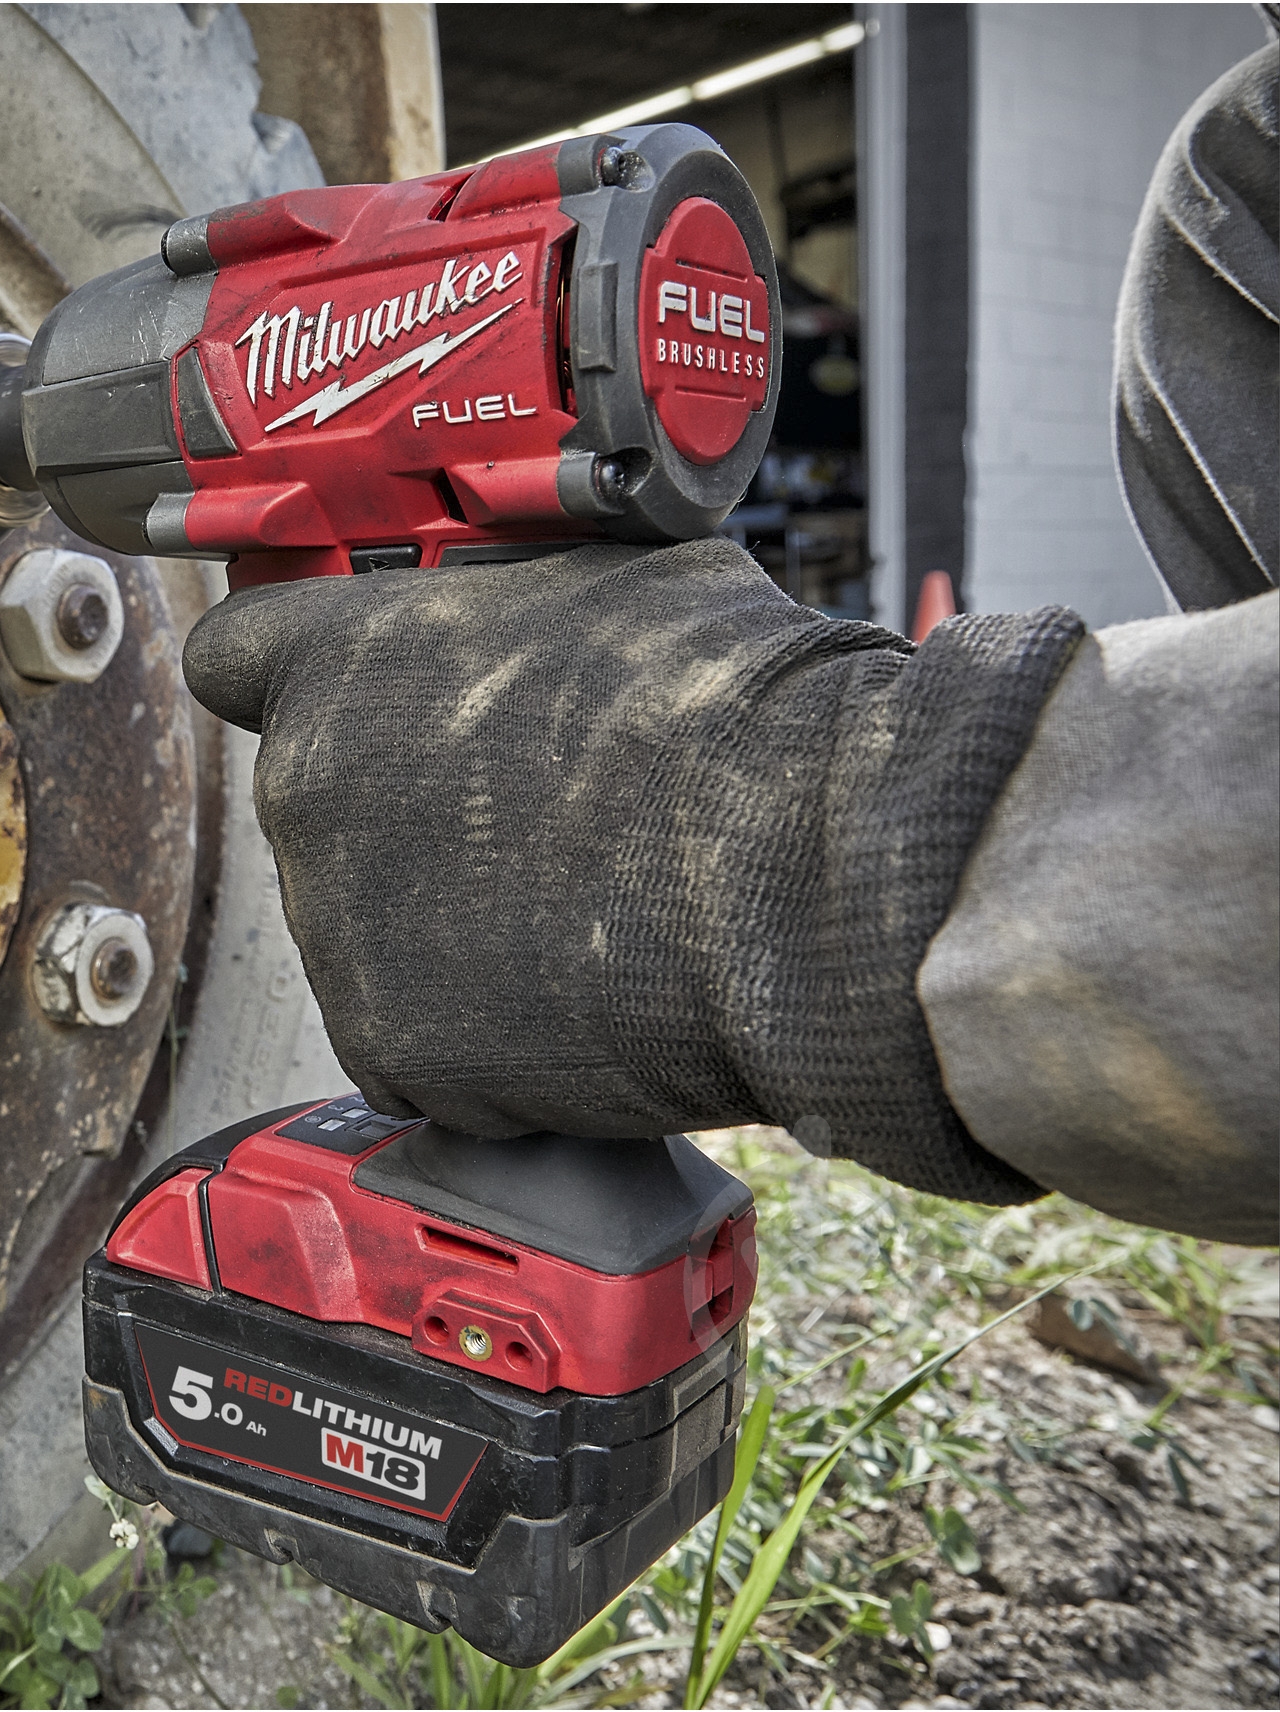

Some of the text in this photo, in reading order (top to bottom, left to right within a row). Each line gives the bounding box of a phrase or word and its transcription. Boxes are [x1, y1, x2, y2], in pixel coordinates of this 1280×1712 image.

[234, 251, 523, 407] Milwaukee
[658, 281, 765, 343] FUEL
[657, 338, 764, 378] BRUSHLESS
[412, 393, 537, 428] FUEL
[169, 1365, 267, 1437] 5.0 Ah
[224, 1367, 442, 1460] REDLITHIUM
[326, 1433, 421, 1491] M18
